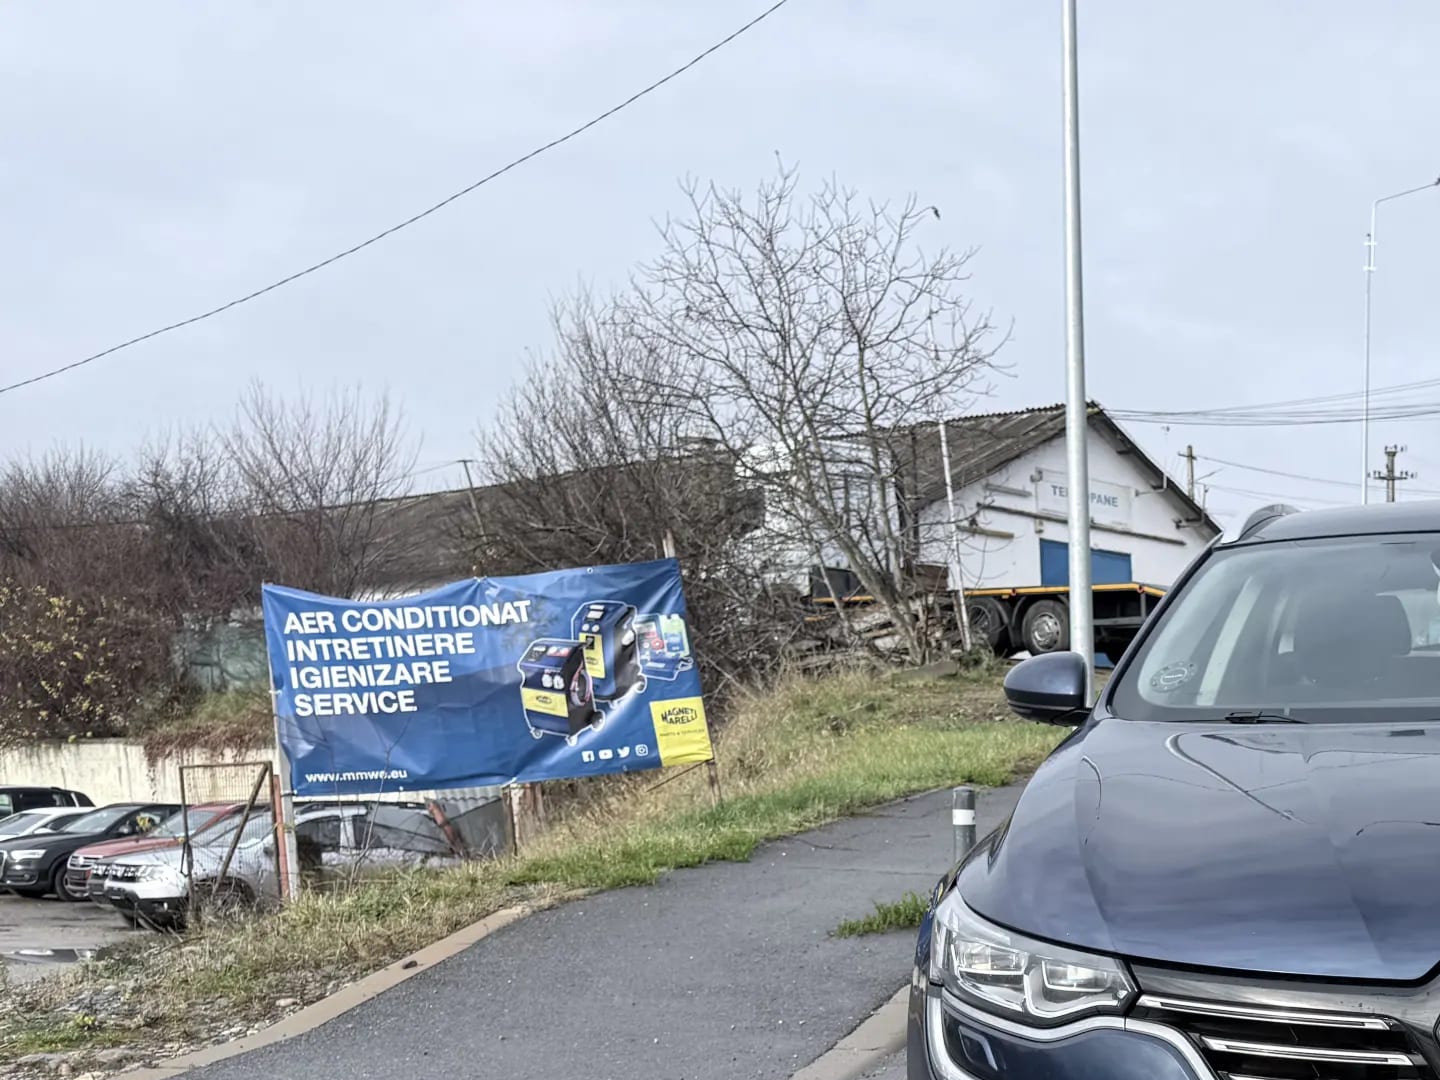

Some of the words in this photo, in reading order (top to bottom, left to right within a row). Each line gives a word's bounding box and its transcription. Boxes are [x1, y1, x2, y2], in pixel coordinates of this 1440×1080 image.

[1050, 484, 1119, 508] TEPANE
[283, 610, 337, 635] AER
[341, 599, 532, 633] CONDITIONAT
[286, 632, 476, 662] INTRETINERE
[290, 661, 453, 689] IGIENIZARE
[294, 690, 418, 717] SERVICE
